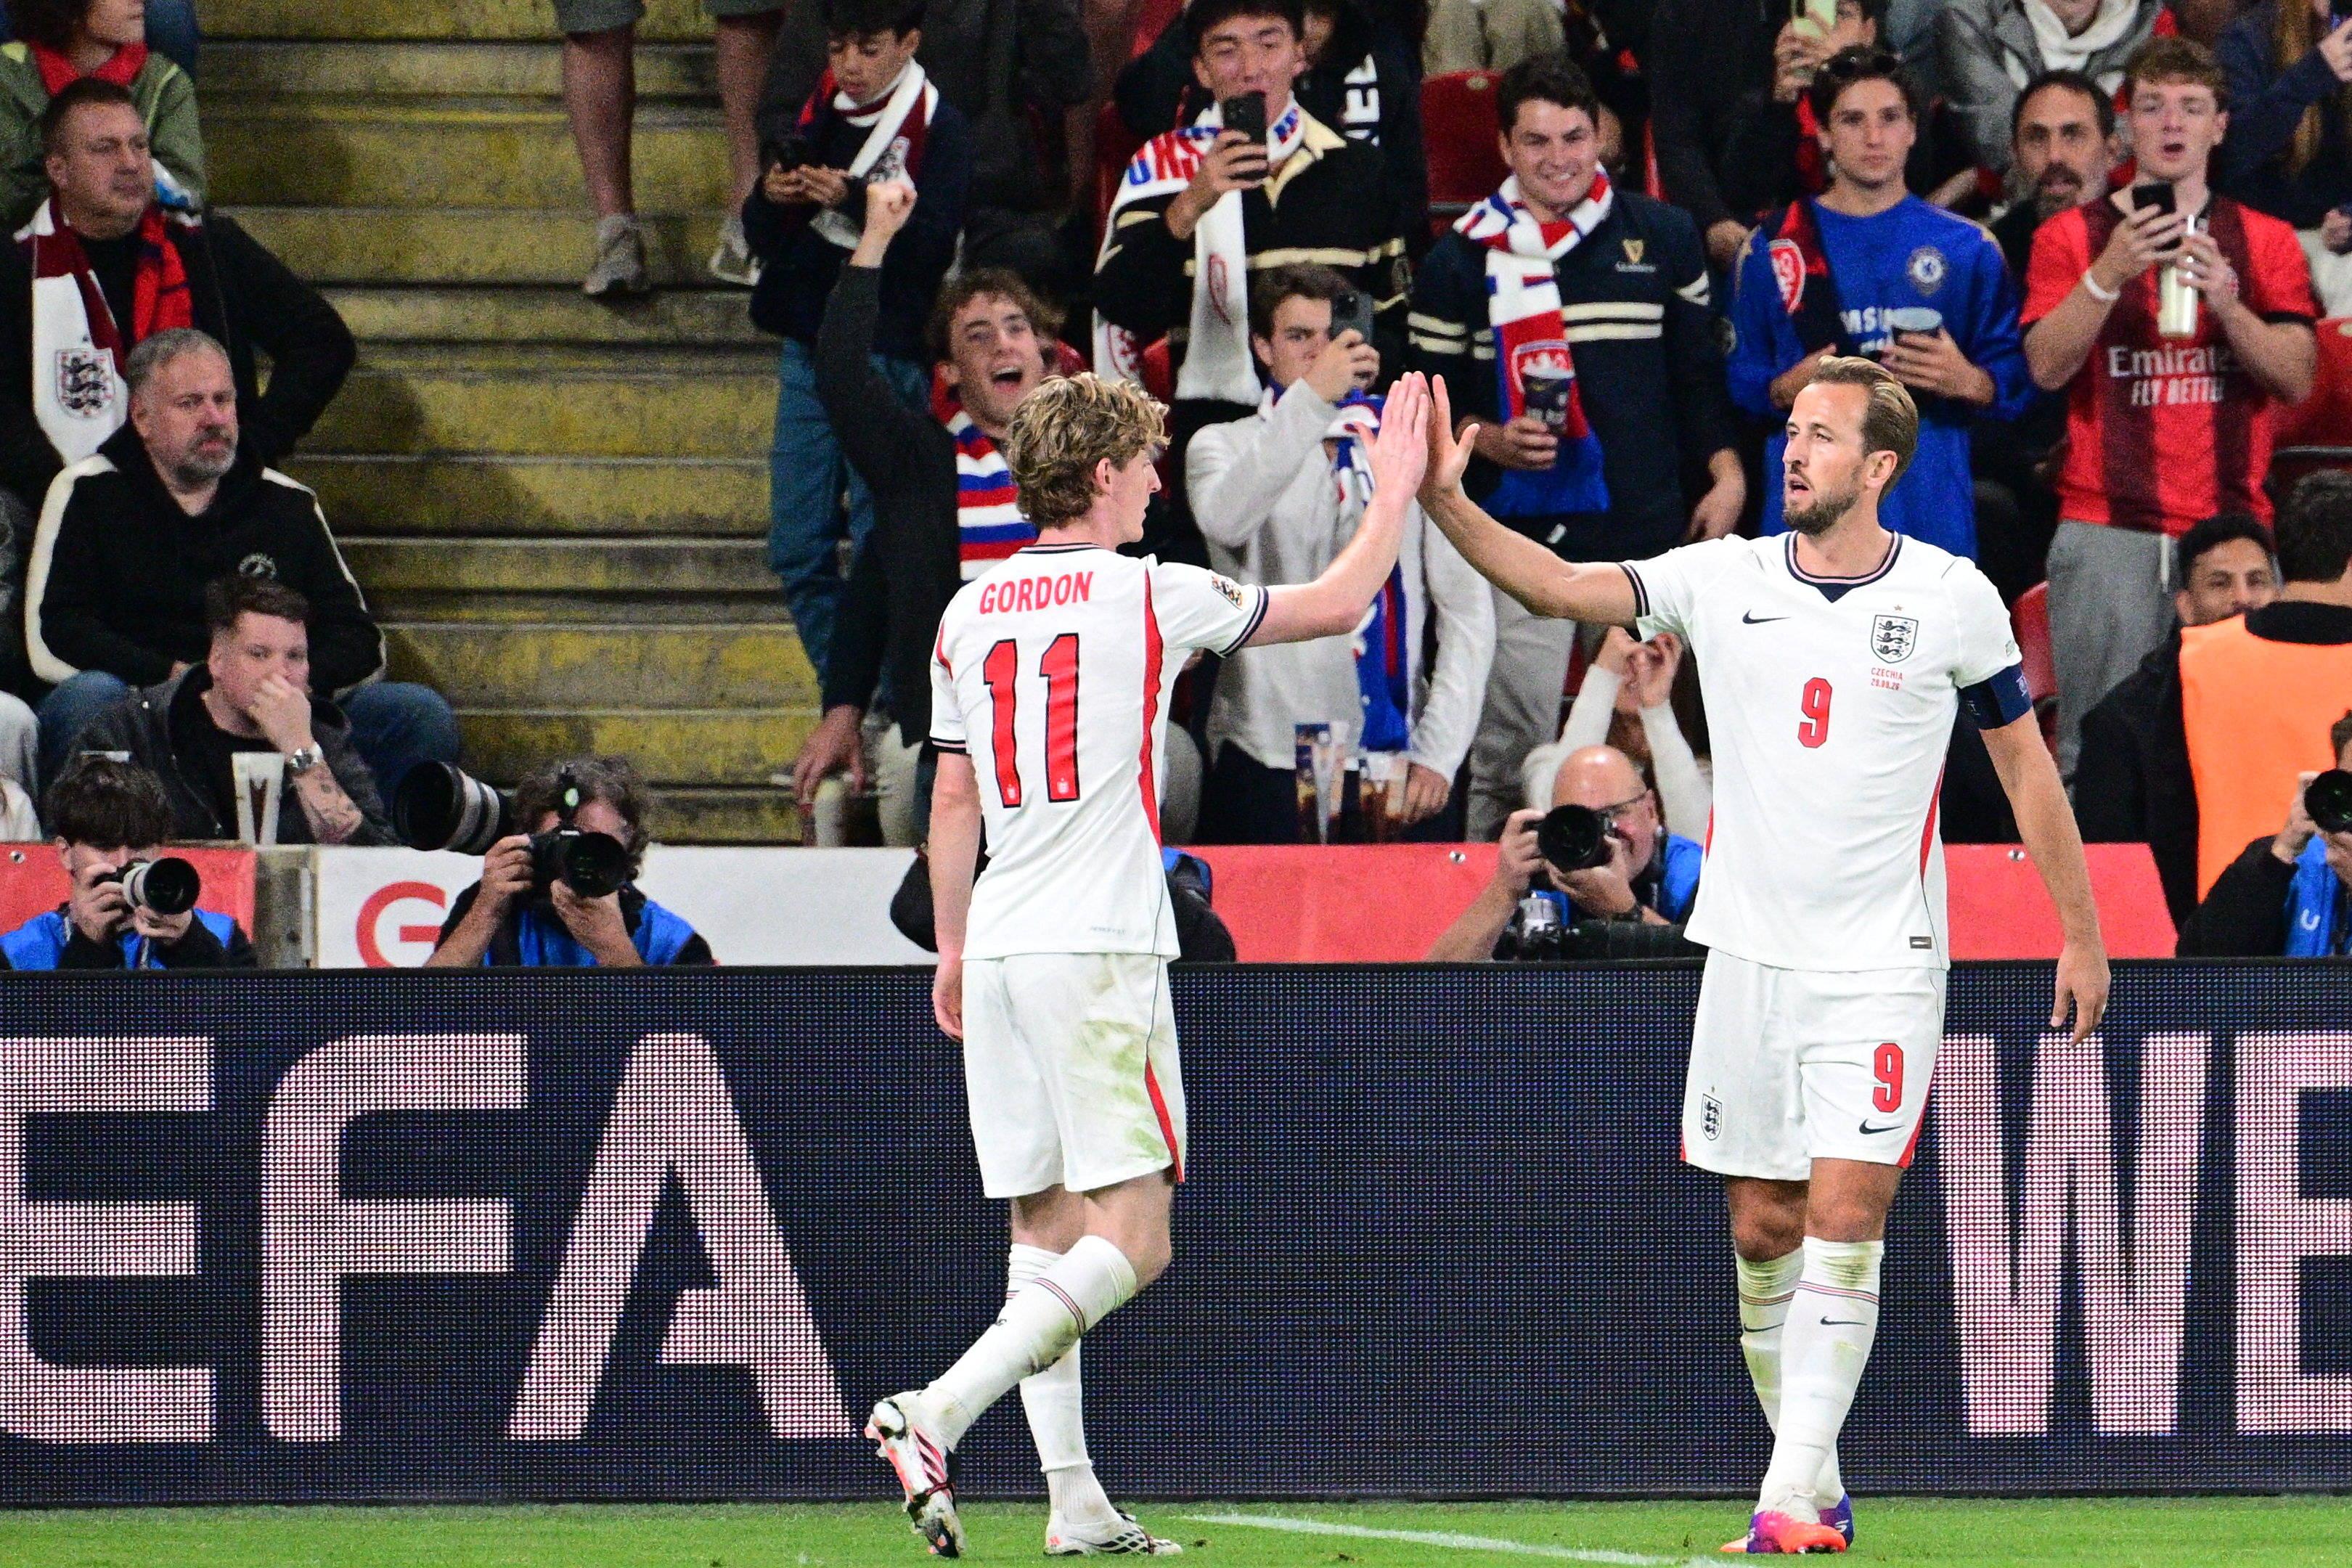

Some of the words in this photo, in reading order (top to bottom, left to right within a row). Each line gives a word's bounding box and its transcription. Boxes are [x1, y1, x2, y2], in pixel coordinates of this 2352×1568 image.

[979, 571, 1093, 616] GORDON
[1871, 666, 1903, 681] CZECHIA
[982, 632, 1080, 809] 11
[1797, 677, 1833, 749] 9
[1872, 1042, 1903, 1113] 9
[0, 1032, 857, 1444] EFA
[1929, 1031, 2352, 1437] WE
